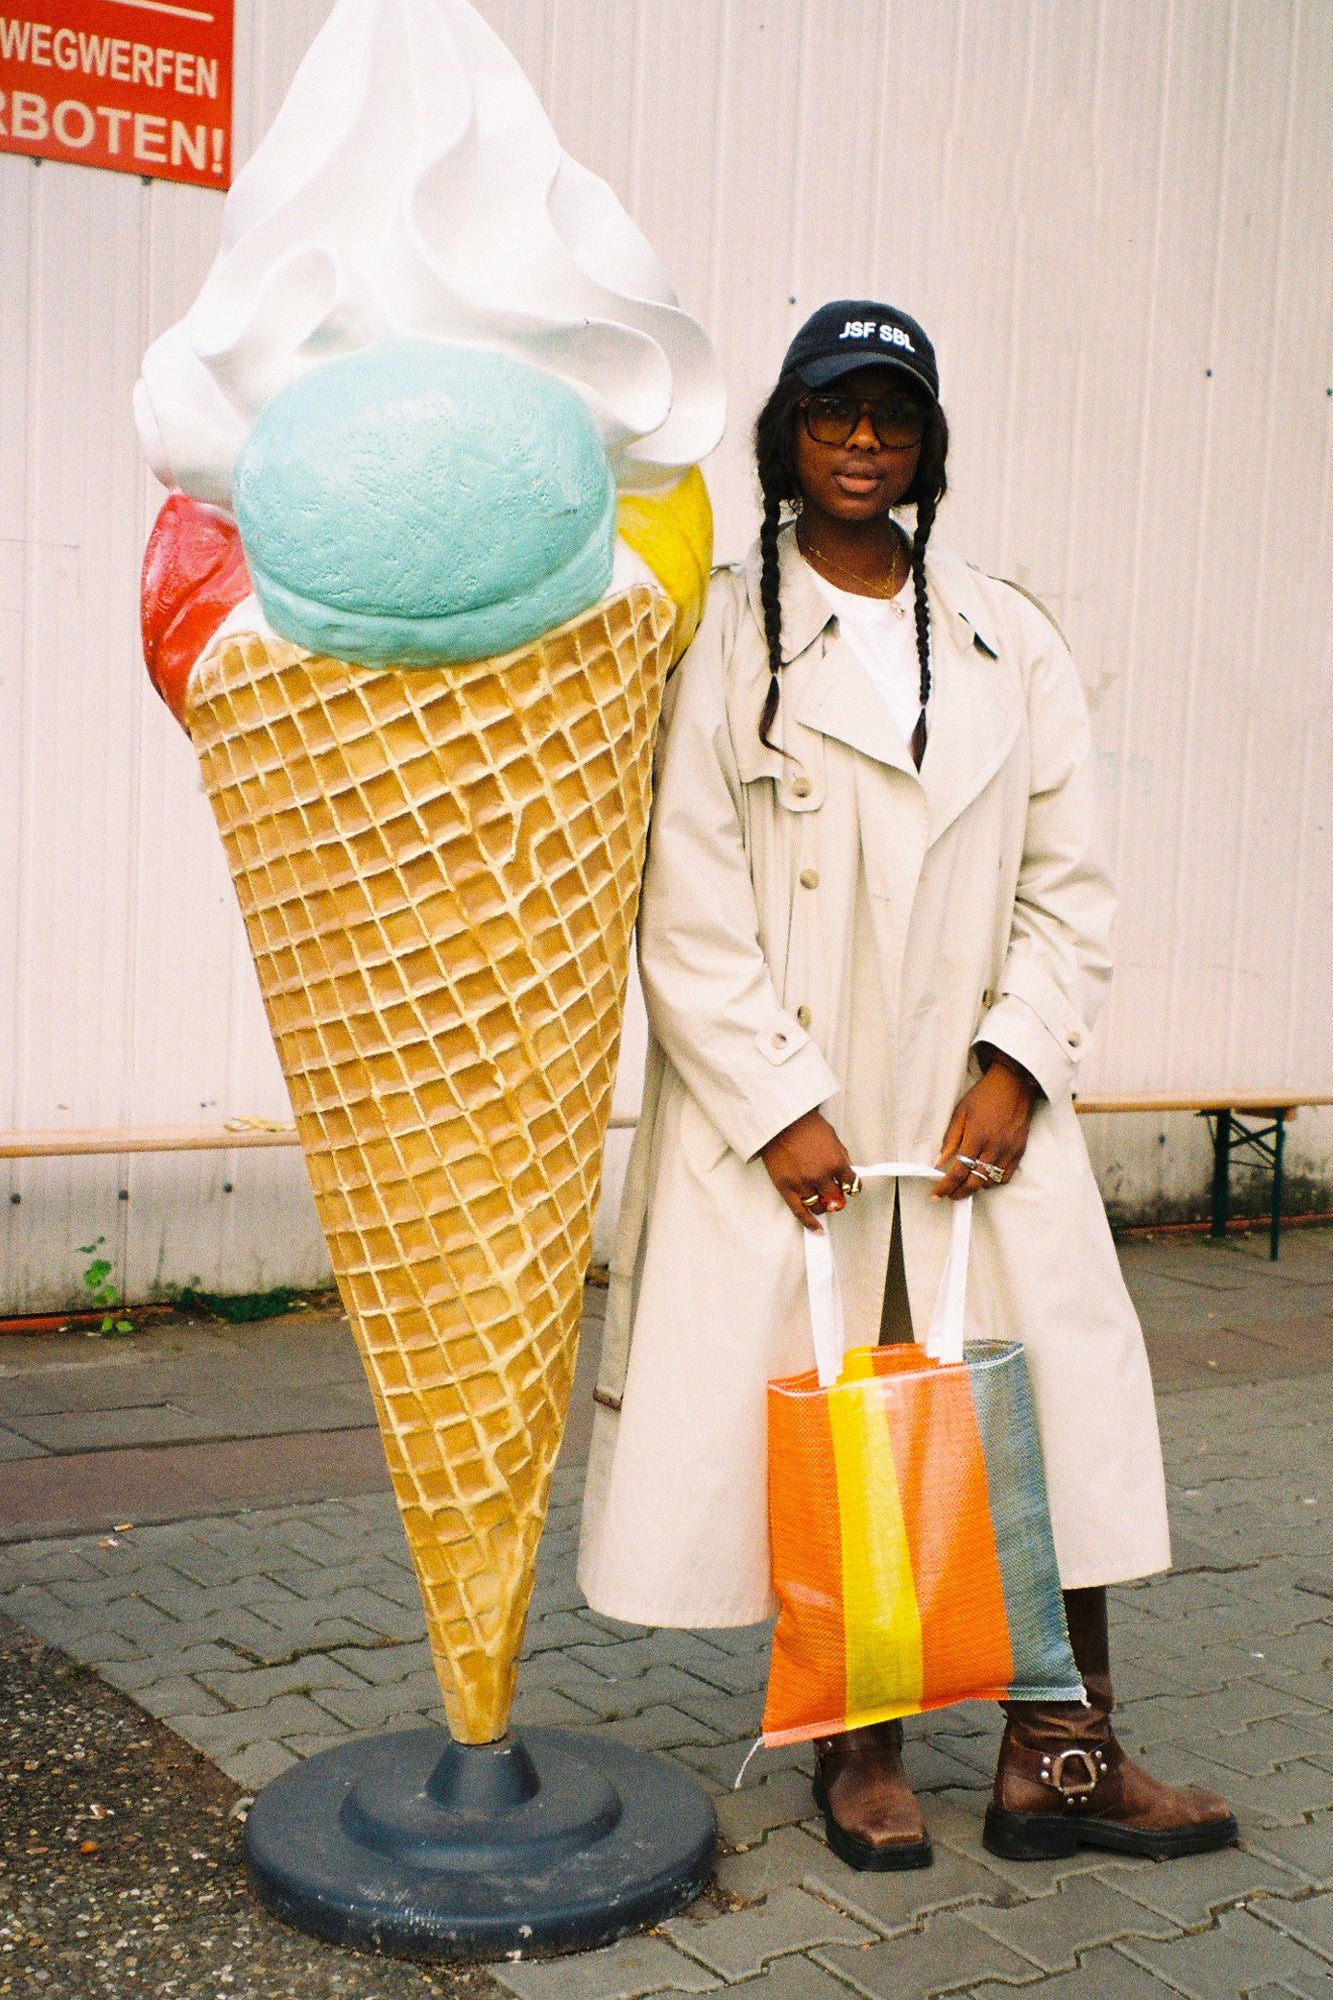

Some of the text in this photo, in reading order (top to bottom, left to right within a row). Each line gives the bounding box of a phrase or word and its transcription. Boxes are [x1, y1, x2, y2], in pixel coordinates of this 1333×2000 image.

[0, 17, 218, 99] WEGWERFEN
[0, 89, 224, 173] BOTEN!
[839, 321, 915, 352] JSF SBL
